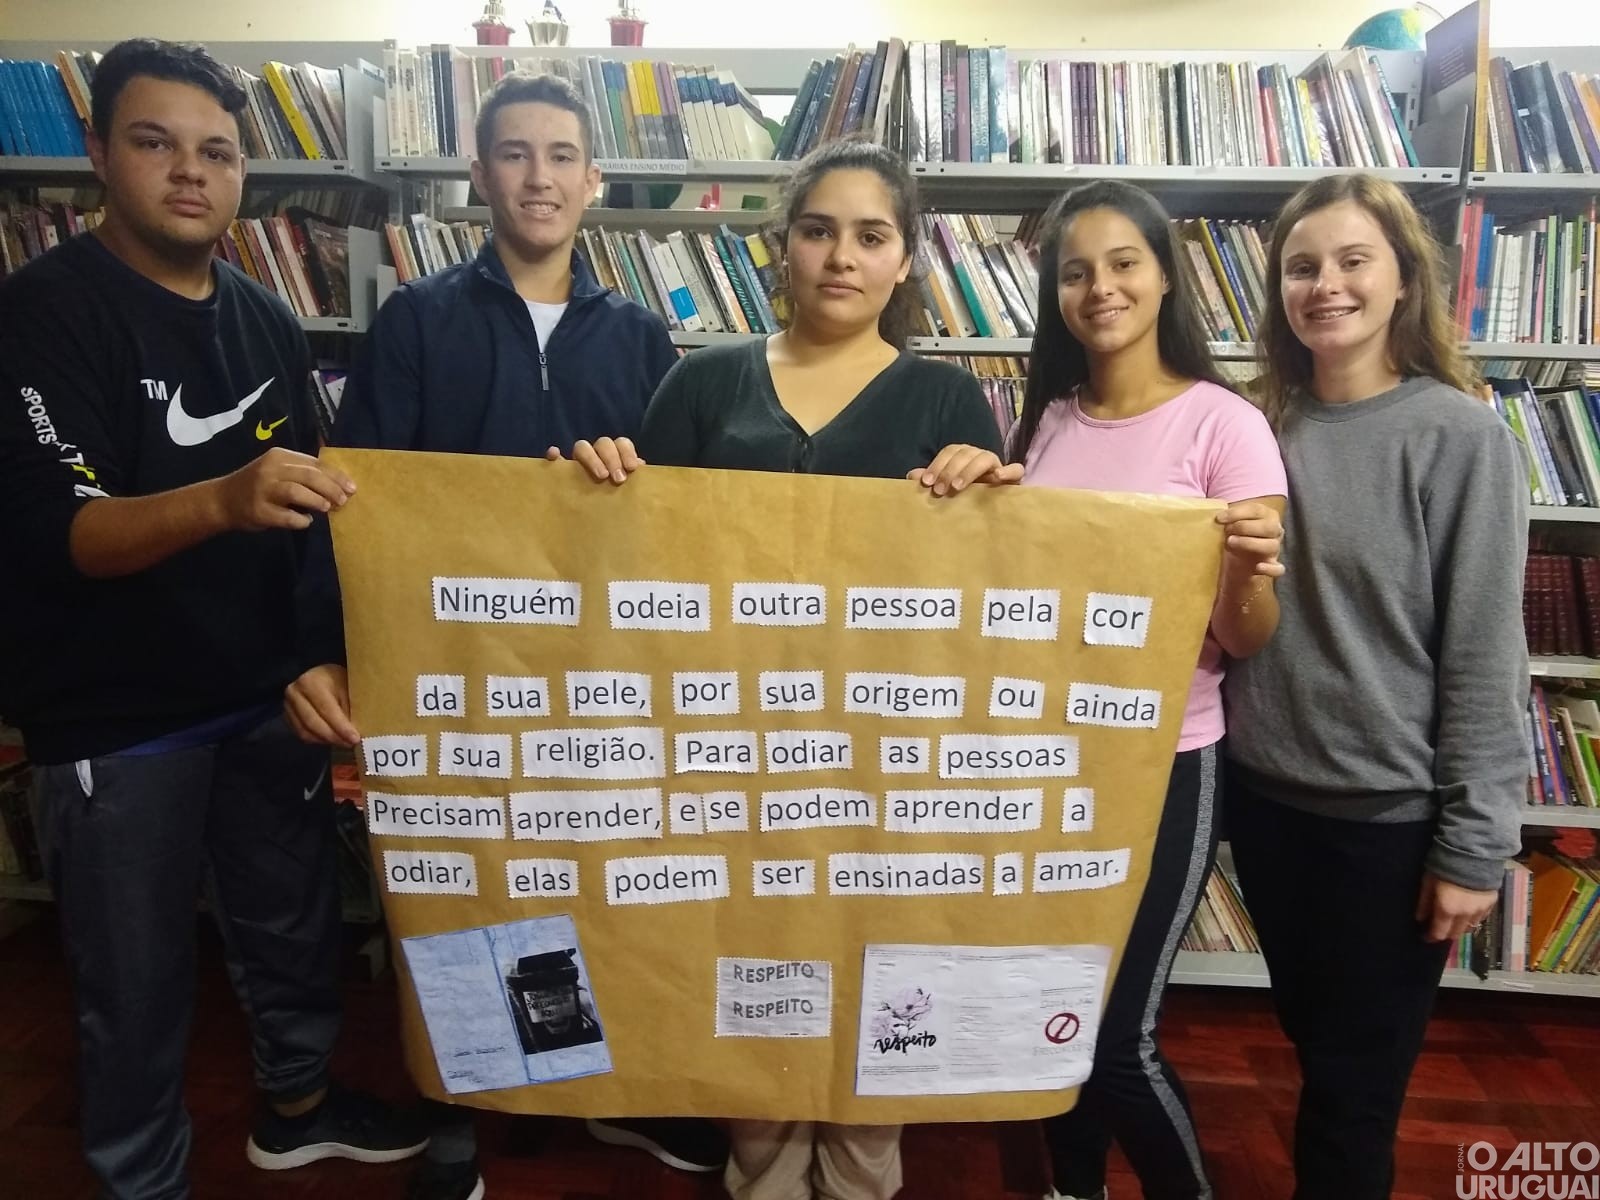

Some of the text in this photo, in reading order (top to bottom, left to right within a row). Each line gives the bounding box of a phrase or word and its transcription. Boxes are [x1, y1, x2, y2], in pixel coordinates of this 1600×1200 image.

[438, 585, 1144, 629] Ninguém odeia outra pessoa pela cor
[423, 677, 1155, 723] da sua pele, por sua origem ou ainda
[372, 735, 1066, 774] por sua religião. Para odiar as pessoas
[373, 792, 1086, 834] Precisam aprender, e se podem aprender a
[391, 858, 1119, 897] odiar, elas podem ser ensinadas a amar.
[733, 962, 814, 983] RESPEITO
[733, 998, 813, 1019] RESPEITO
[873, 1032, 937, 1056] respeito
